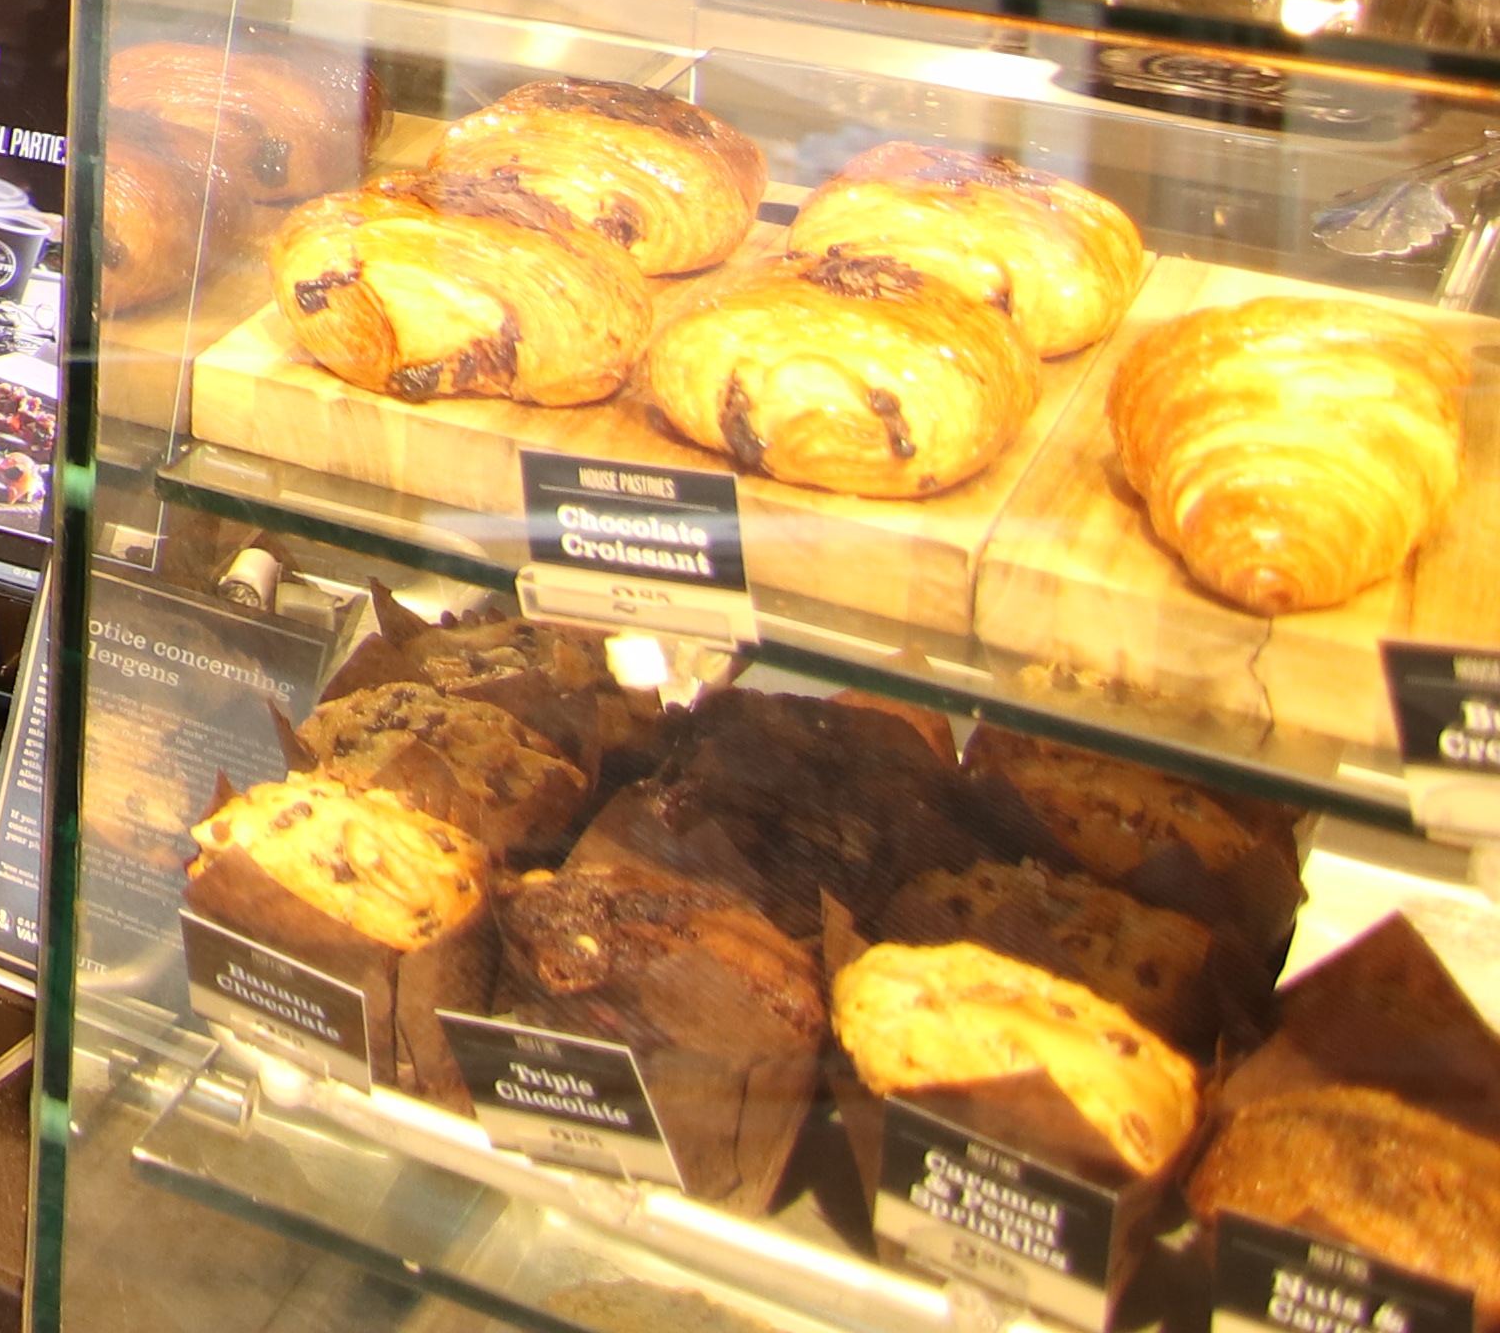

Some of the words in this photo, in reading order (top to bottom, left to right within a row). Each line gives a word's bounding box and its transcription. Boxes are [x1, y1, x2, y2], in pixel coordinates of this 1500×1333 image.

[579, 467, 618, 493] HOUSE
[556, 504, 708, 547] Chocolate
[560, 532, 713, 576] Croissant
[153, 637, 296, 703] concerning
[215, 972, 340, 1043] Chocolate
[228, 961, 325, 1020] Banana
[494, 1079, 630, 1128] Chocolate
[509, 1060, 596, 1099] Triple
[925, 1149, 1063, 1228] Caramel
[910, 1185, 1070, 1274] Sprinkles
[1272, 1268, 1367, 1325] Nuts
